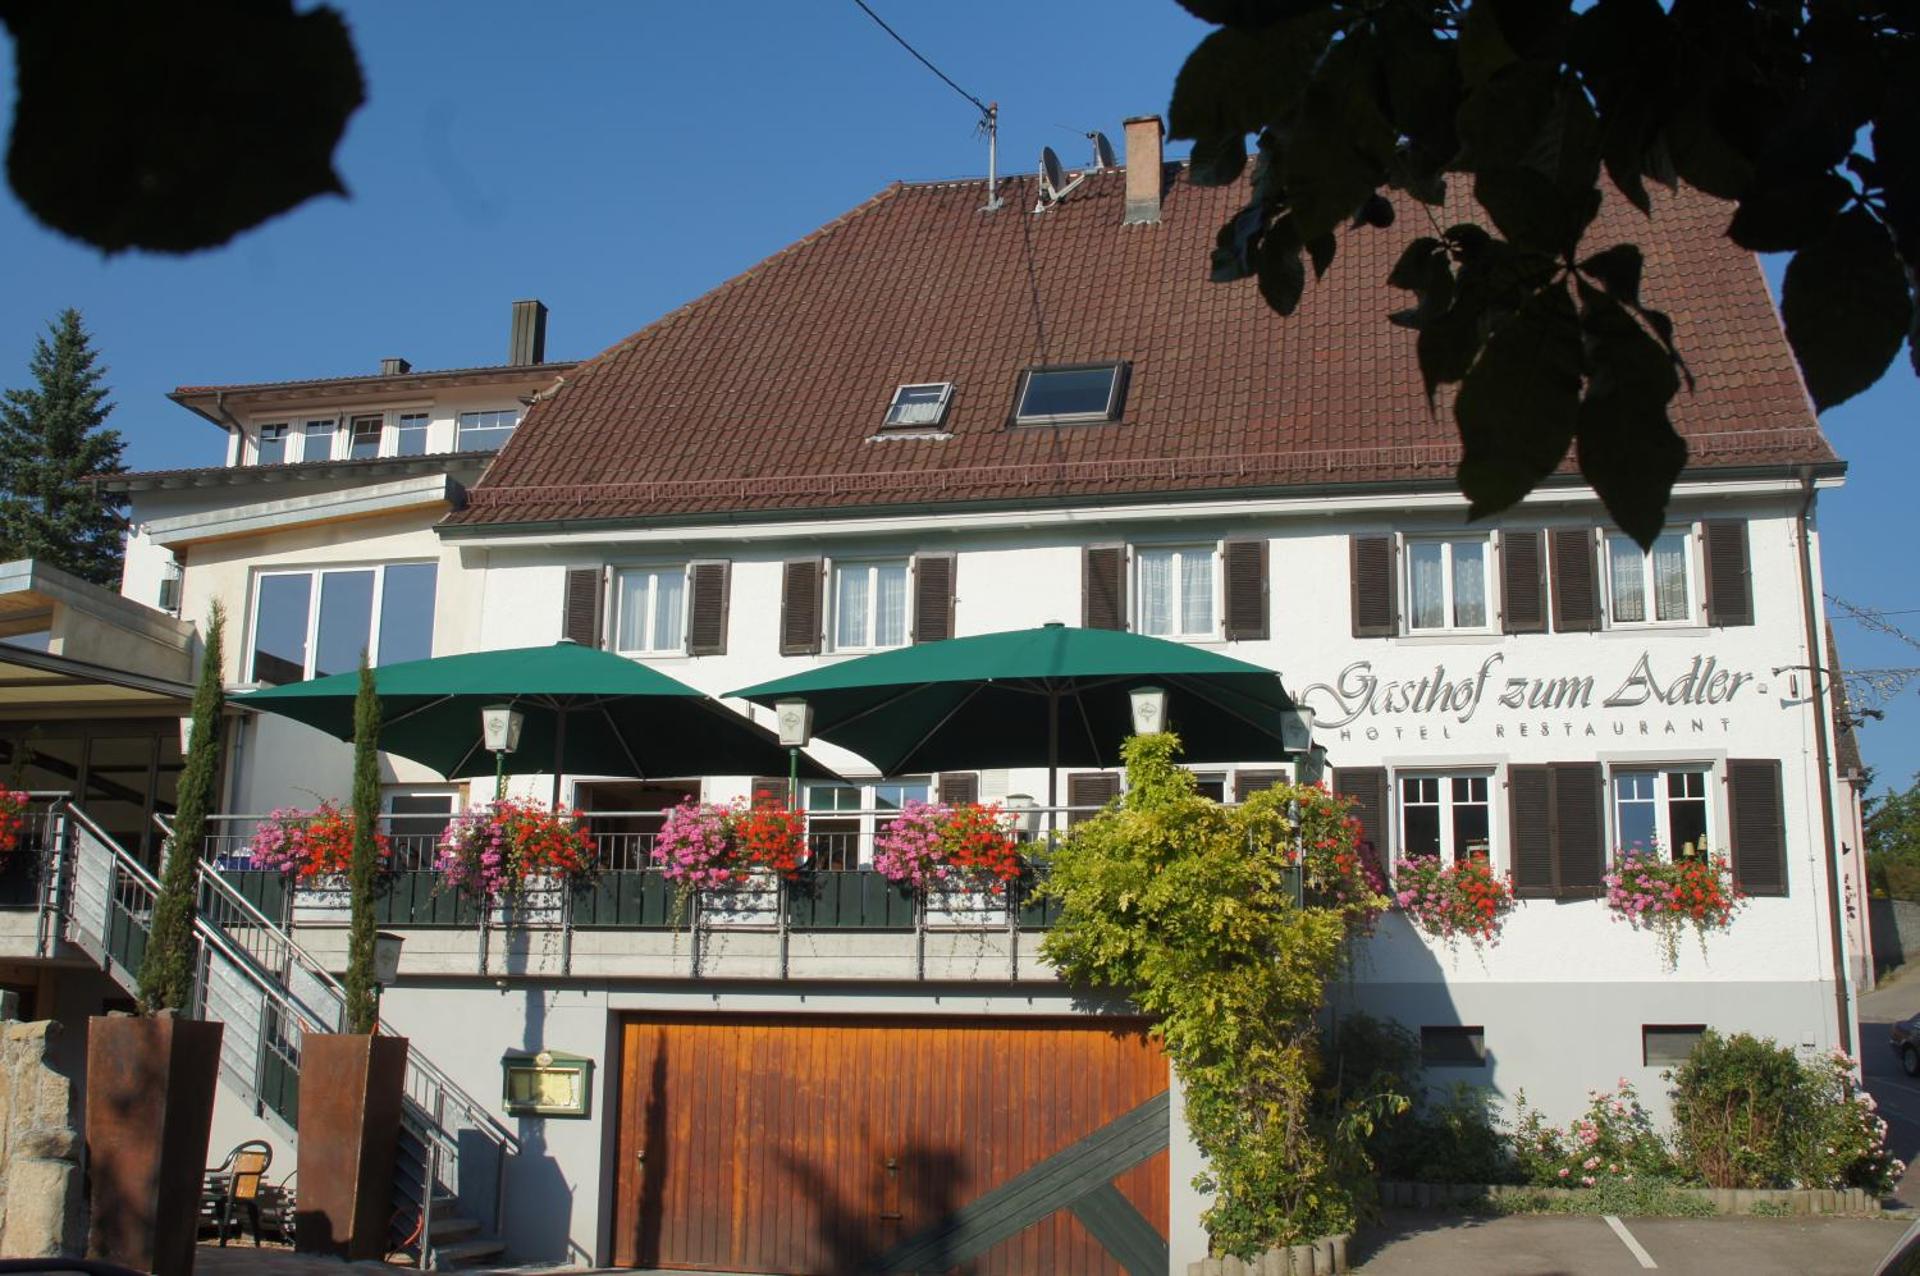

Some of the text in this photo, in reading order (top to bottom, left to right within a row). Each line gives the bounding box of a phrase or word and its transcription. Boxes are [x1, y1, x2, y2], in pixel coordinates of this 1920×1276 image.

[1302, 650, 1754, 729] Gasthof zum Adler
[1340, 717, 1730, 741] HOTEL RESTAURANT
